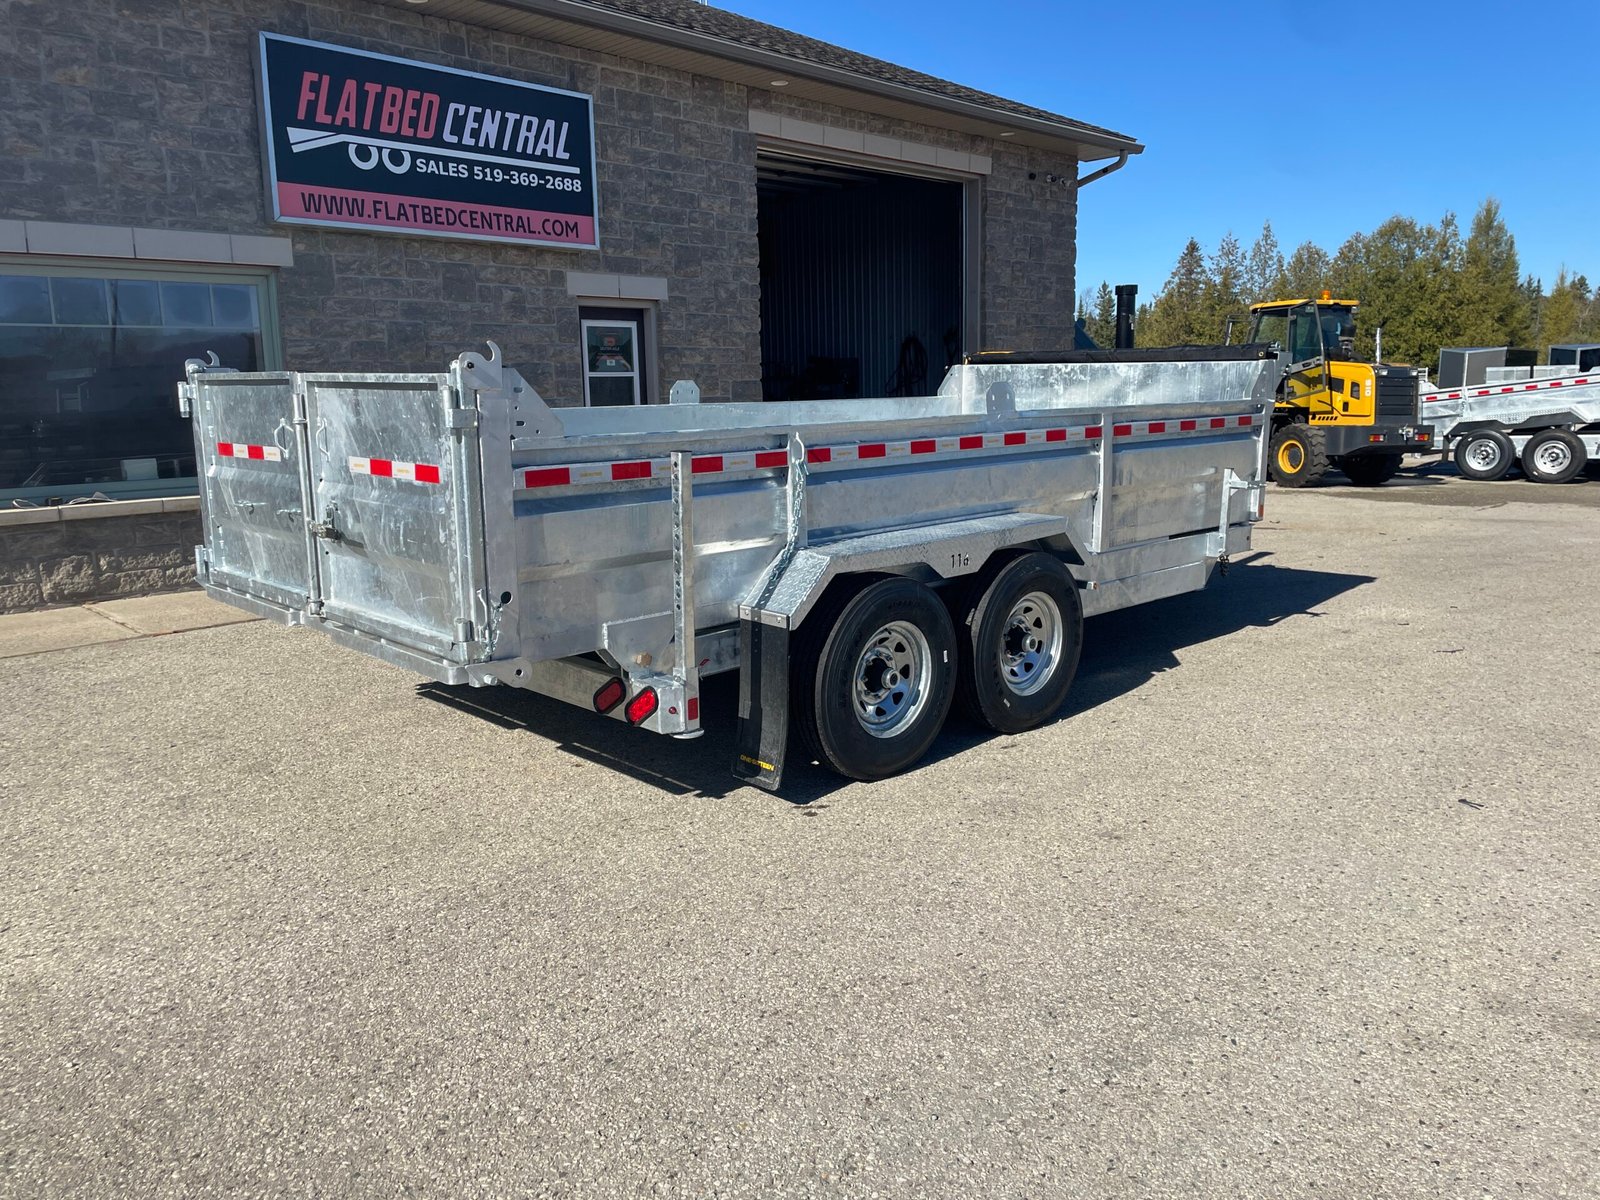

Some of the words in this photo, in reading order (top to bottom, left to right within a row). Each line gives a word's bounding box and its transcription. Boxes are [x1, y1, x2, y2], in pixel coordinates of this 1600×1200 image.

[297, 71, 440, 139] FLATBED
[443, 102, 570, 160] CENTRAL
[416, 158, 469, 178] SALES
[473, 166, 582, 192] 519-369-2688
[301, 192, 579, 238] WWW.FLATBEDCENTRAL.COM
